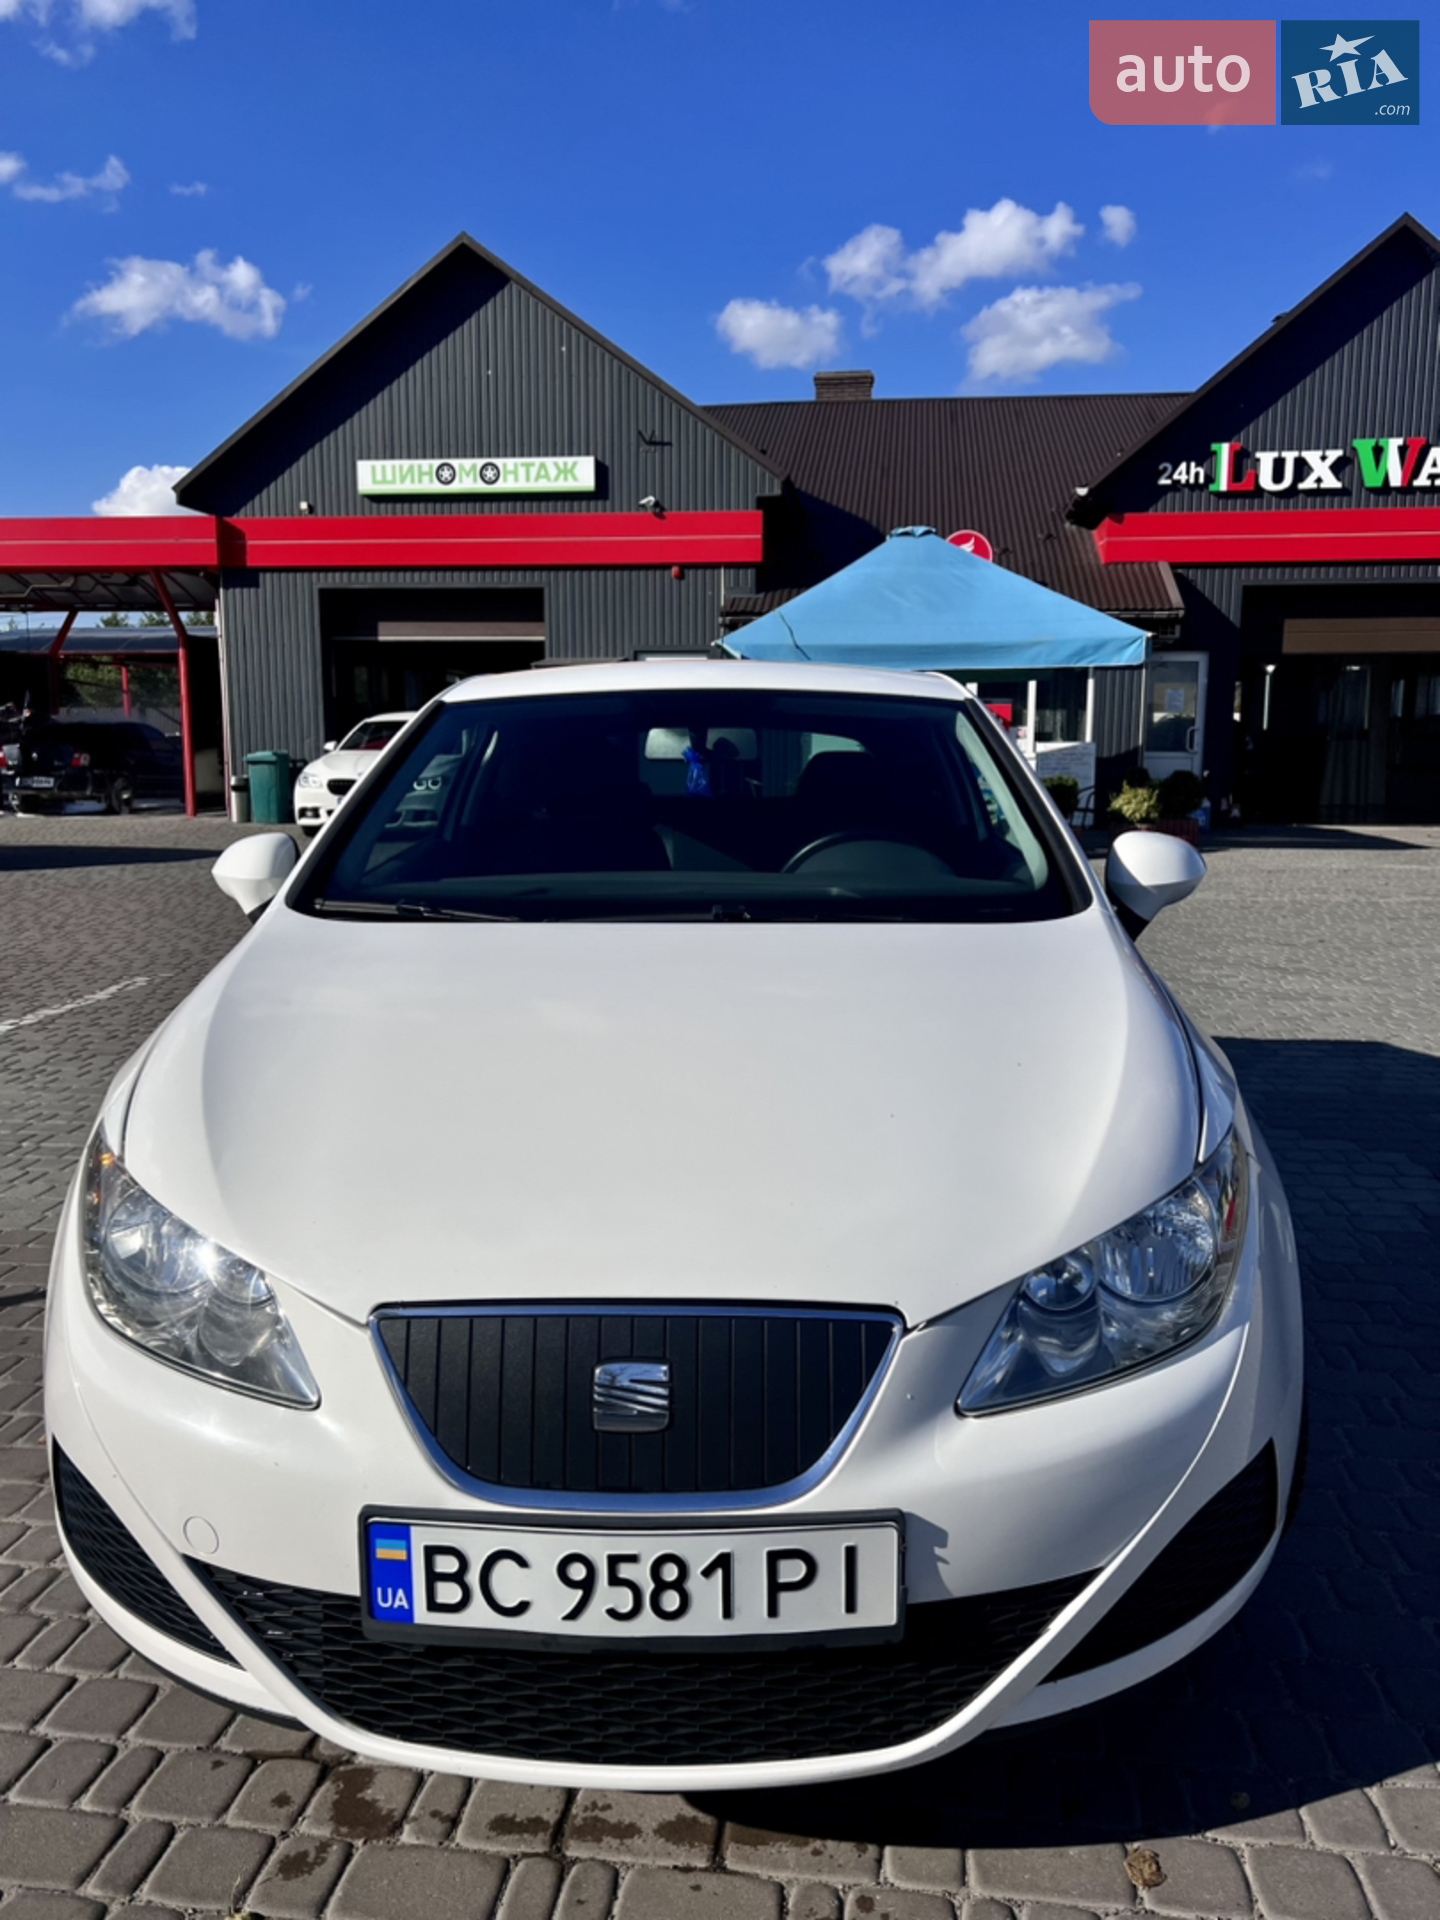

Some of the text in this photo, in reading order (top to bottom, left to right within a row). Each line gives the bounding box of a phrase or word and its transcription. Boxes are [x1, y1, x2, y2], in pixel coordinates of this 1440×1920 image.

[370, 460, 580, 486] ШИНОМОНТАЖ
[1157, 461, 1205, 485] 24h
[1208, 441, 1344, 492] LUX
[377, 1587, 409, 1610] UA
[422, 1543, 859, 1622] BC 9581 PI
